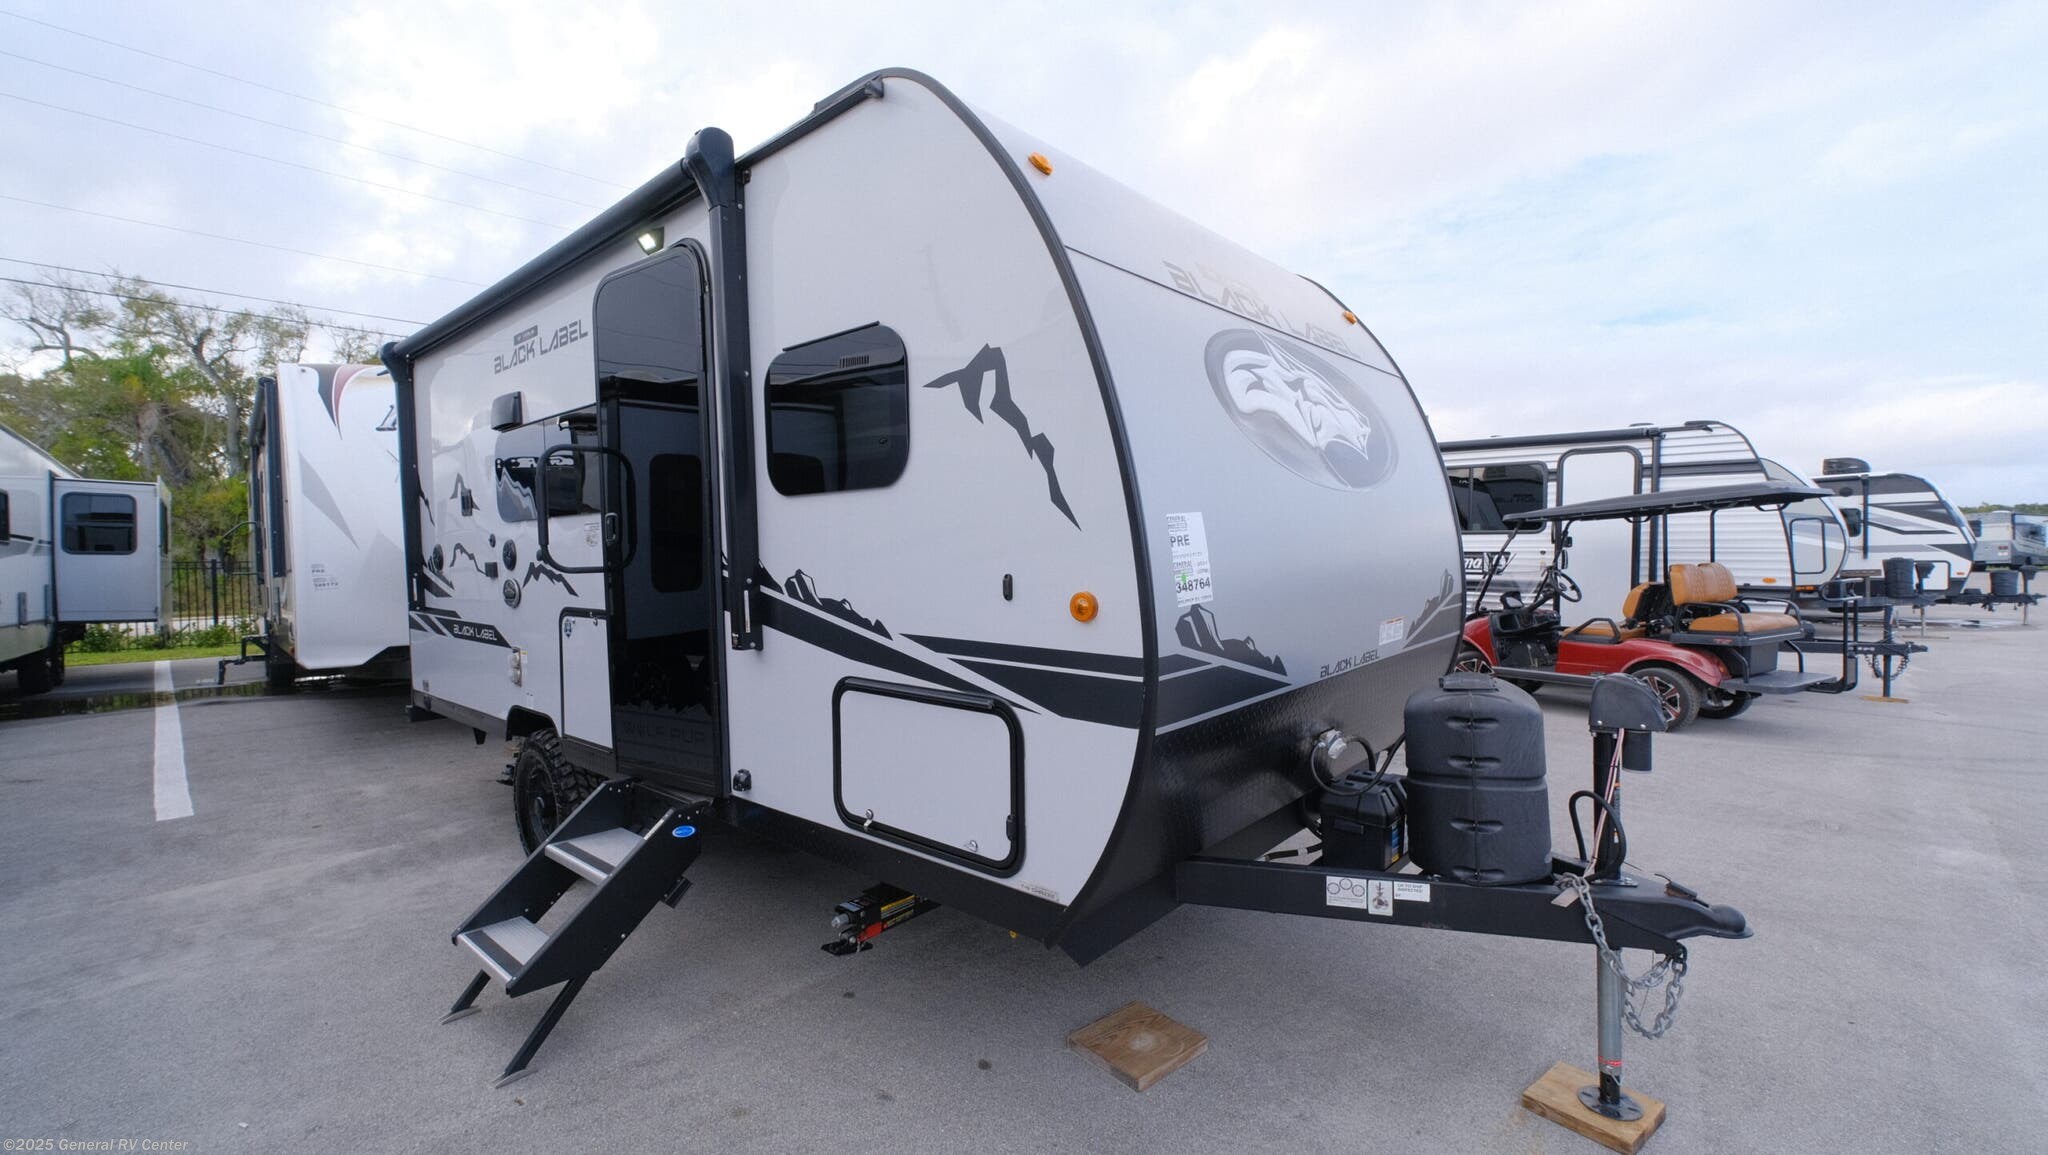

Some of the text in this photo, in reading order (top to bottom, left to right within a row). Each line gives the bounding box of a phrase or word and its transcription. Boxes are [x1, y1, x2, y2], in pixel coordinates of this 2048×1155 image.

[1162, 260, 1282, 328] BLACK
[494, 340, 536, 375] BLACK
[539, 320, 589, 355] LABEL
[1169, 534, 1191, 547] PRE
[1176, 577, 1210, 593] 348764
[453, 624, 498, 641] BLACK LABEL
[1320, 648, 1380, 678] BLACK LABEL
